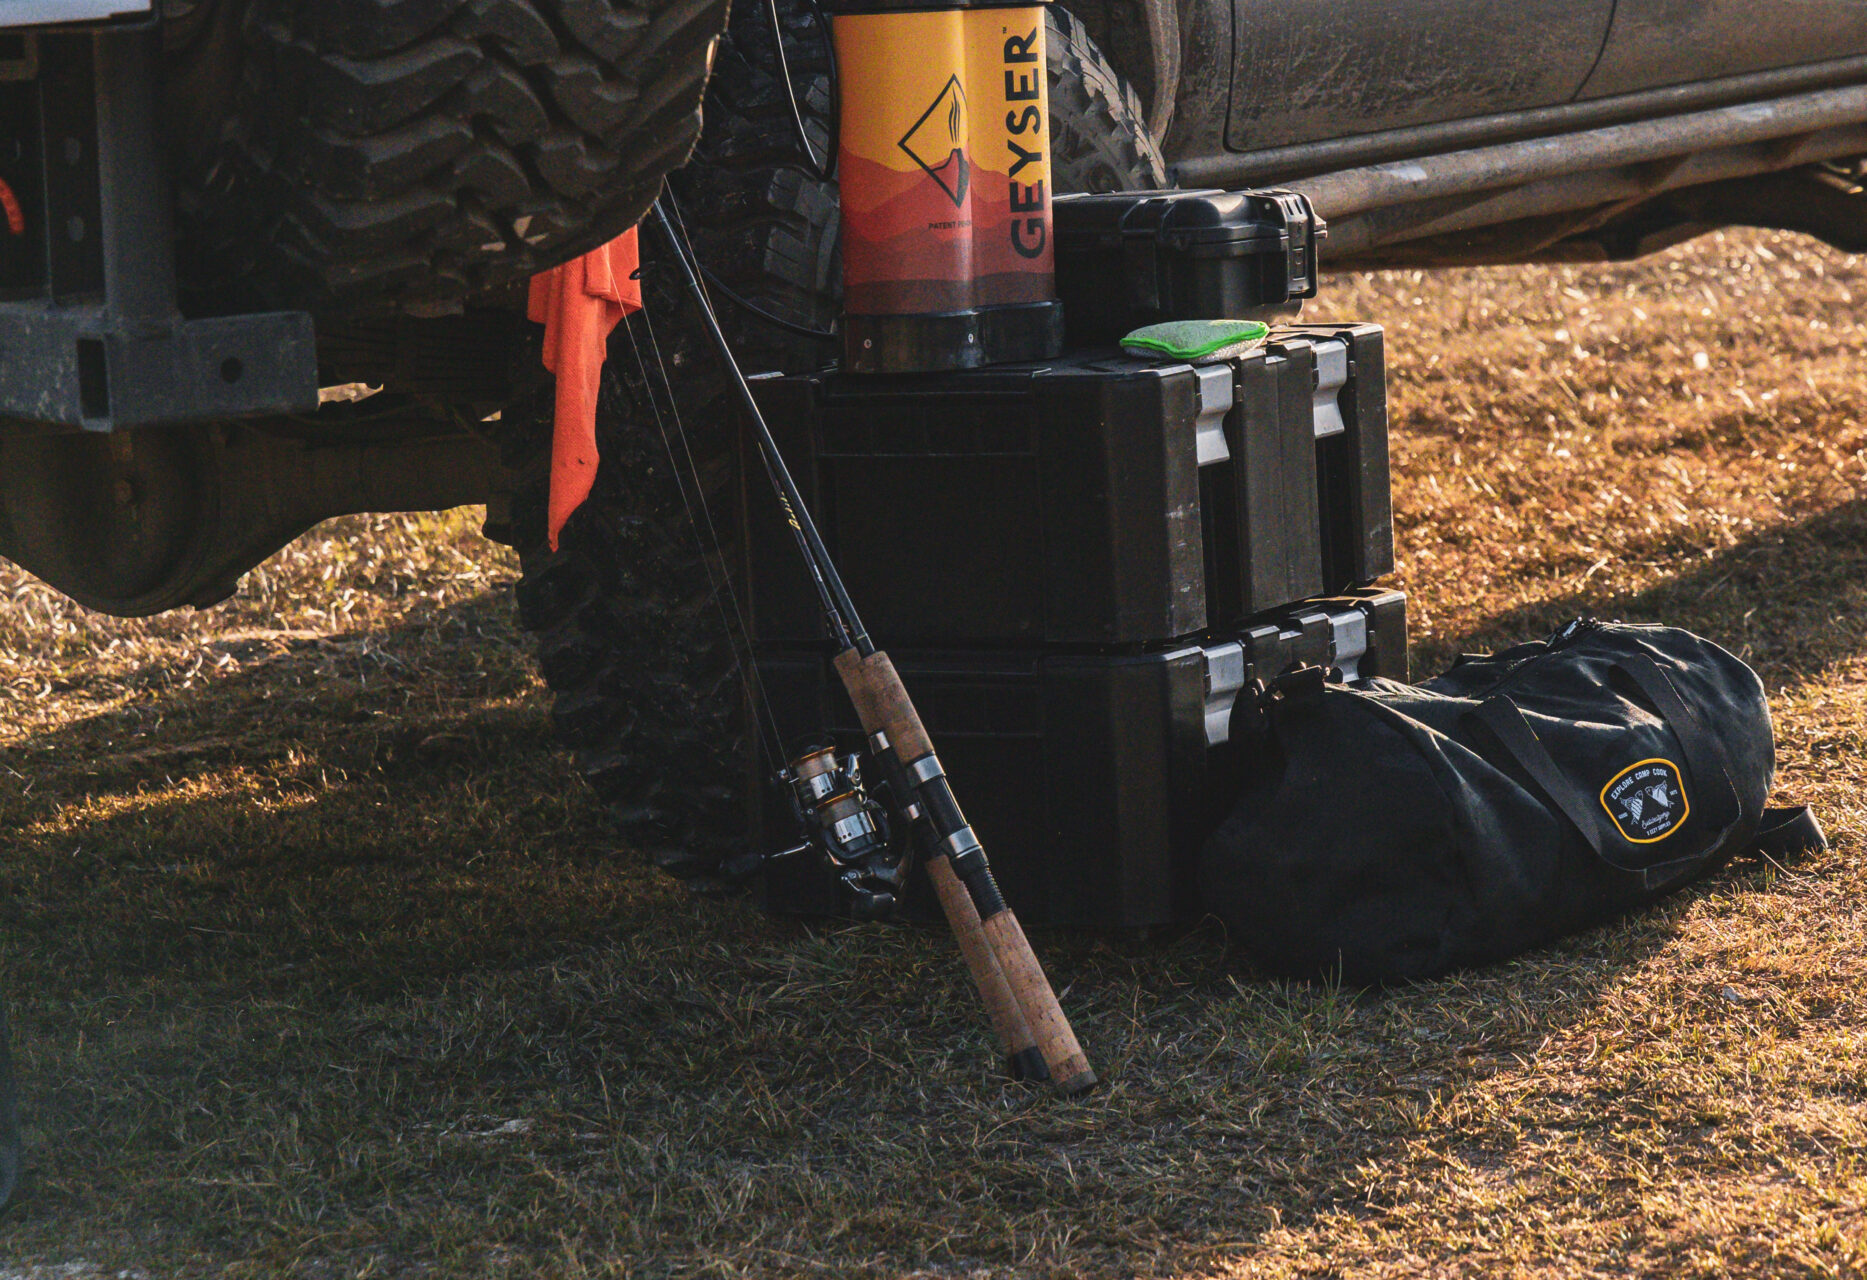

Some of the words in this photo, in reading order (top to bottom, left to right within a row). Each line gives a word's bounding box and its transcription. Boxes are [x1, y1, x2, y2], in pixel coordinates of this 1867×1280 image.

[1003, 26, 1046, 259] GEYSER
[928, 221, 956, 230] PATENT
[1611, 776, 1634, 800] EXPLORE
